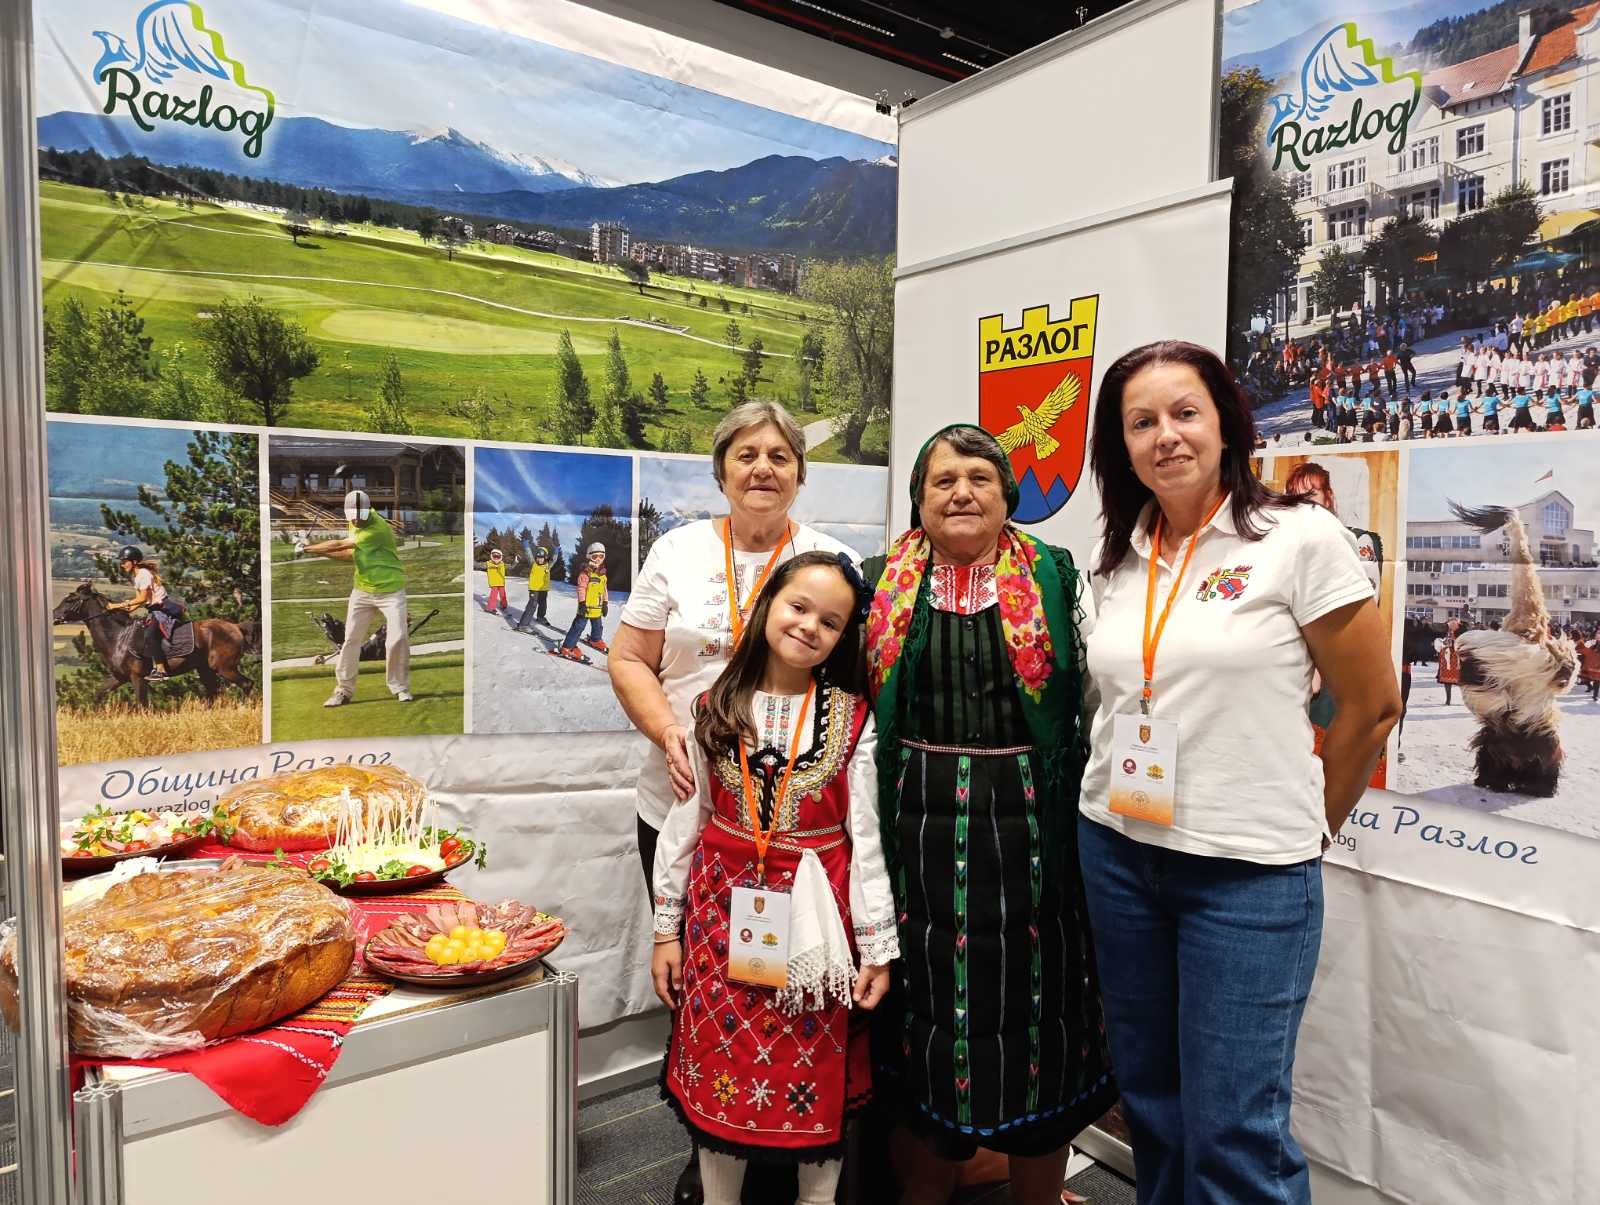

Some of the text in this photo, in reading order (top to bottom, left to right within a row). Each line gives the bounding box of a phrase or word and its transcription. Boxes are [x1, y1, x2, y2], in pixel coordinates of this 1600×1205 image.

[100, 67, 274, 158] Razlog
[1271, 98, 1420, 172] Razlog
[985, 324, 1089, 364] РАЗЛОГ
[101, 766, 259, 799] Община
[1391, 805, 1538, 865] Разлог
